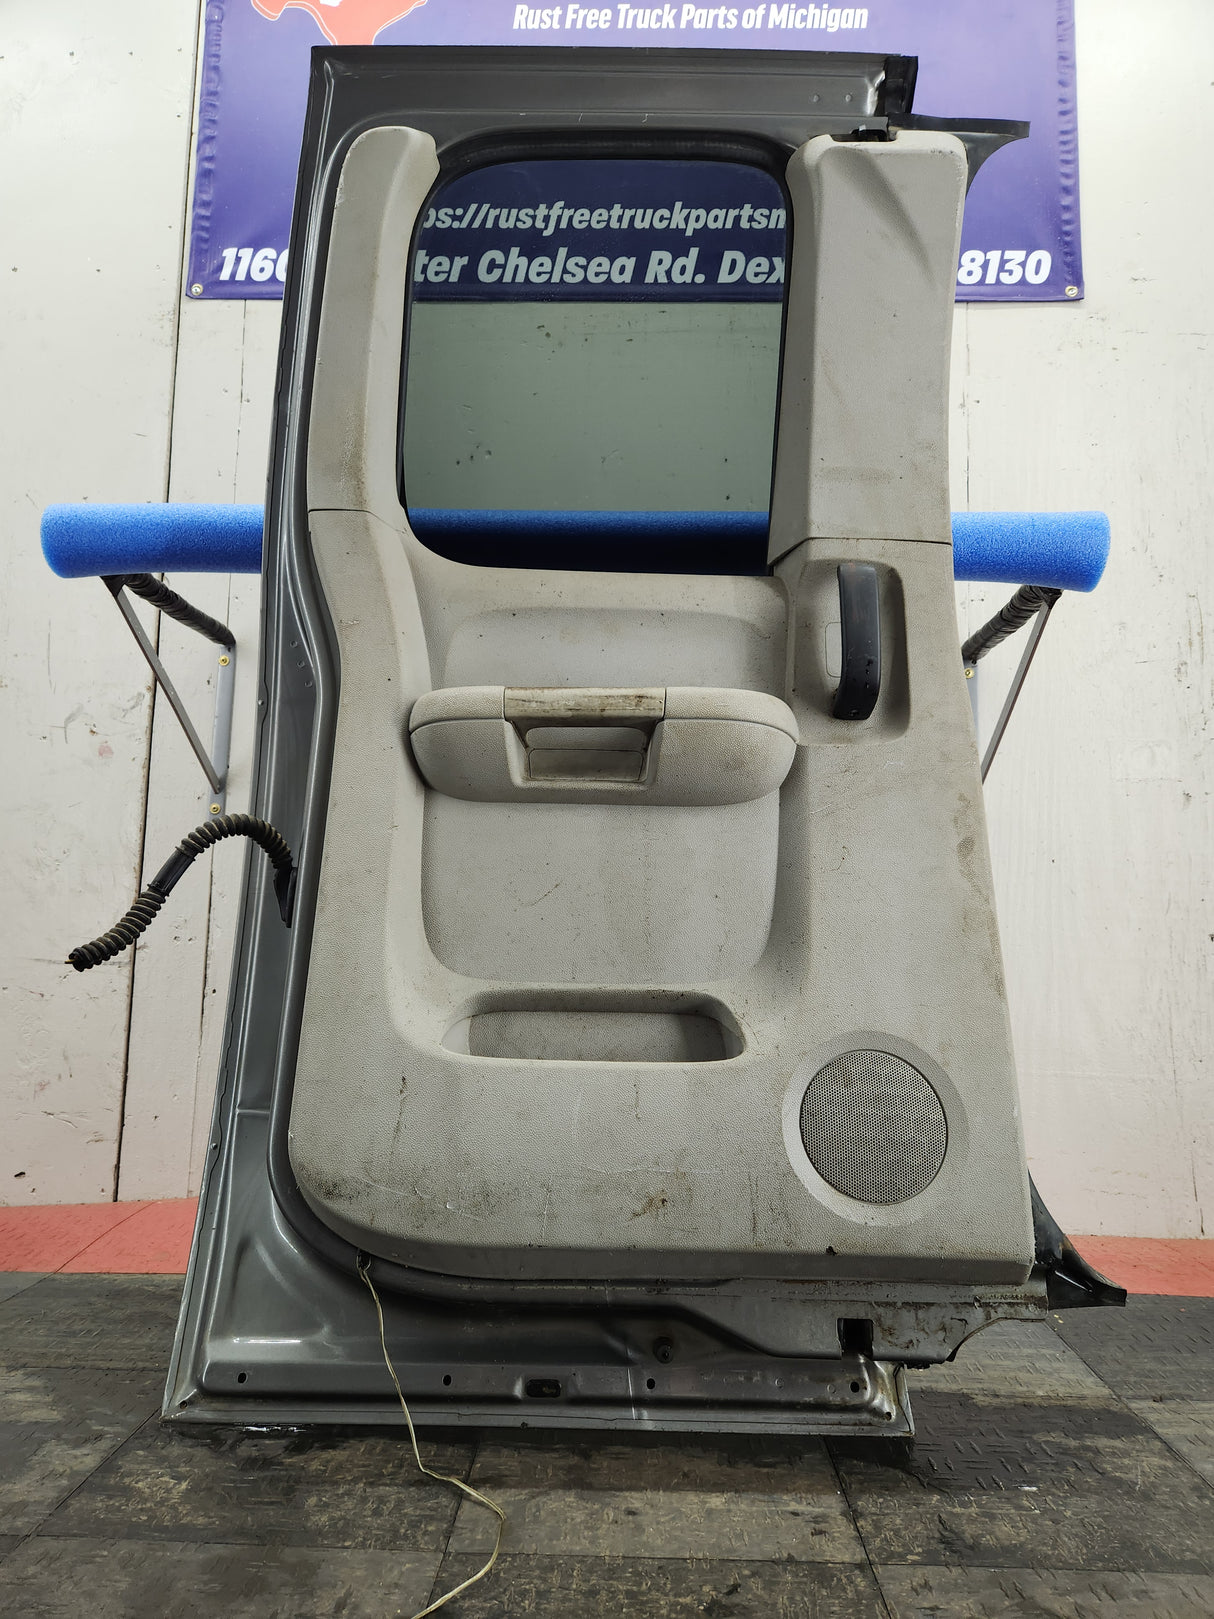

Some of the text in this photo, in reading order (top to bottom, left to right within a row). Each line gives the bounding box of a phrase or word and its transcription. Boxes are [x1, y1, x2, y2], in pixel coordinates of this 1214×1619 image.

[513, 4, 868, 33] Rust Free Truck Parts of Michigan
[477, 247, 636, 284] Chelsea
[644, 248, 706, 284] Rd.
